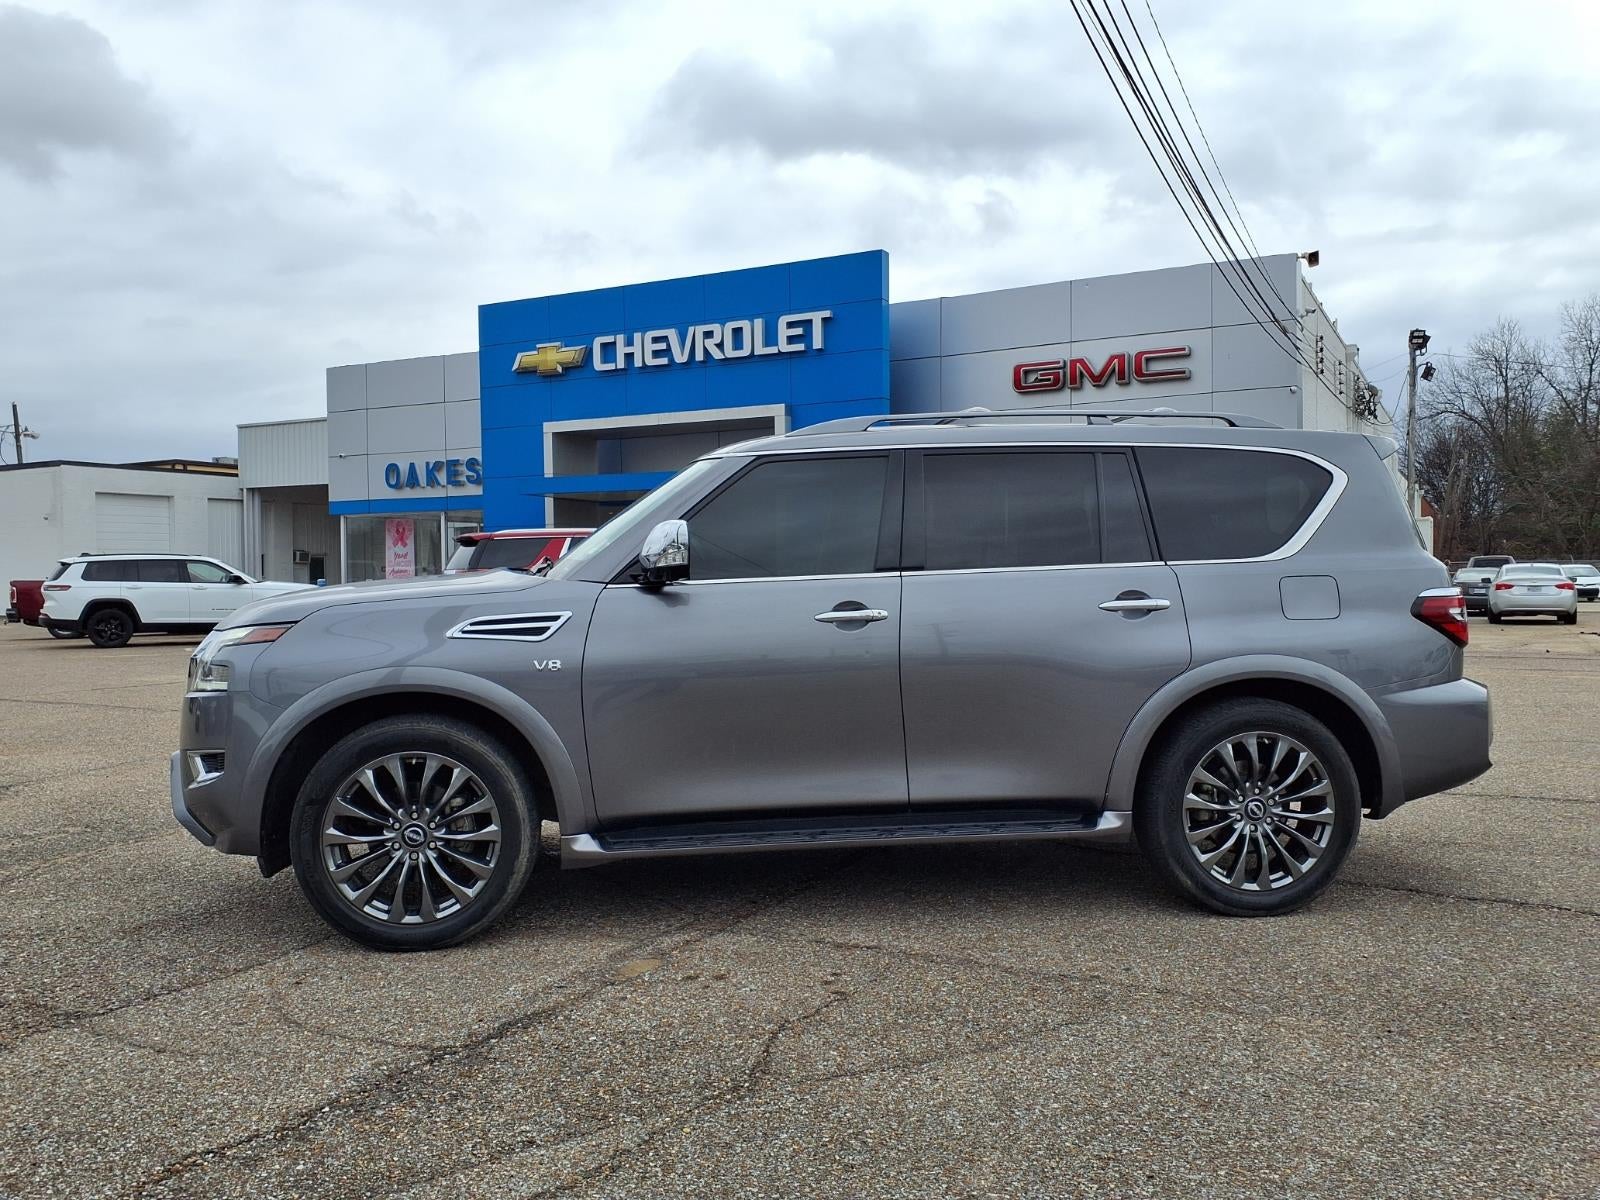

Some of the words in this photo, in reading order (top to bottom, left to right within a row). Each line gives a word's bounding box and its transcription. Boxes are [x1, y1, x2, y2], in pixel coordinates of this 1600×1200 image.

[592, 310, 833, 371] CHEVROLET
[1012, 345, 1191, 393] GMC
[385, 457, 482, 489] OAKES
[533, 659, 562, 671] V8
